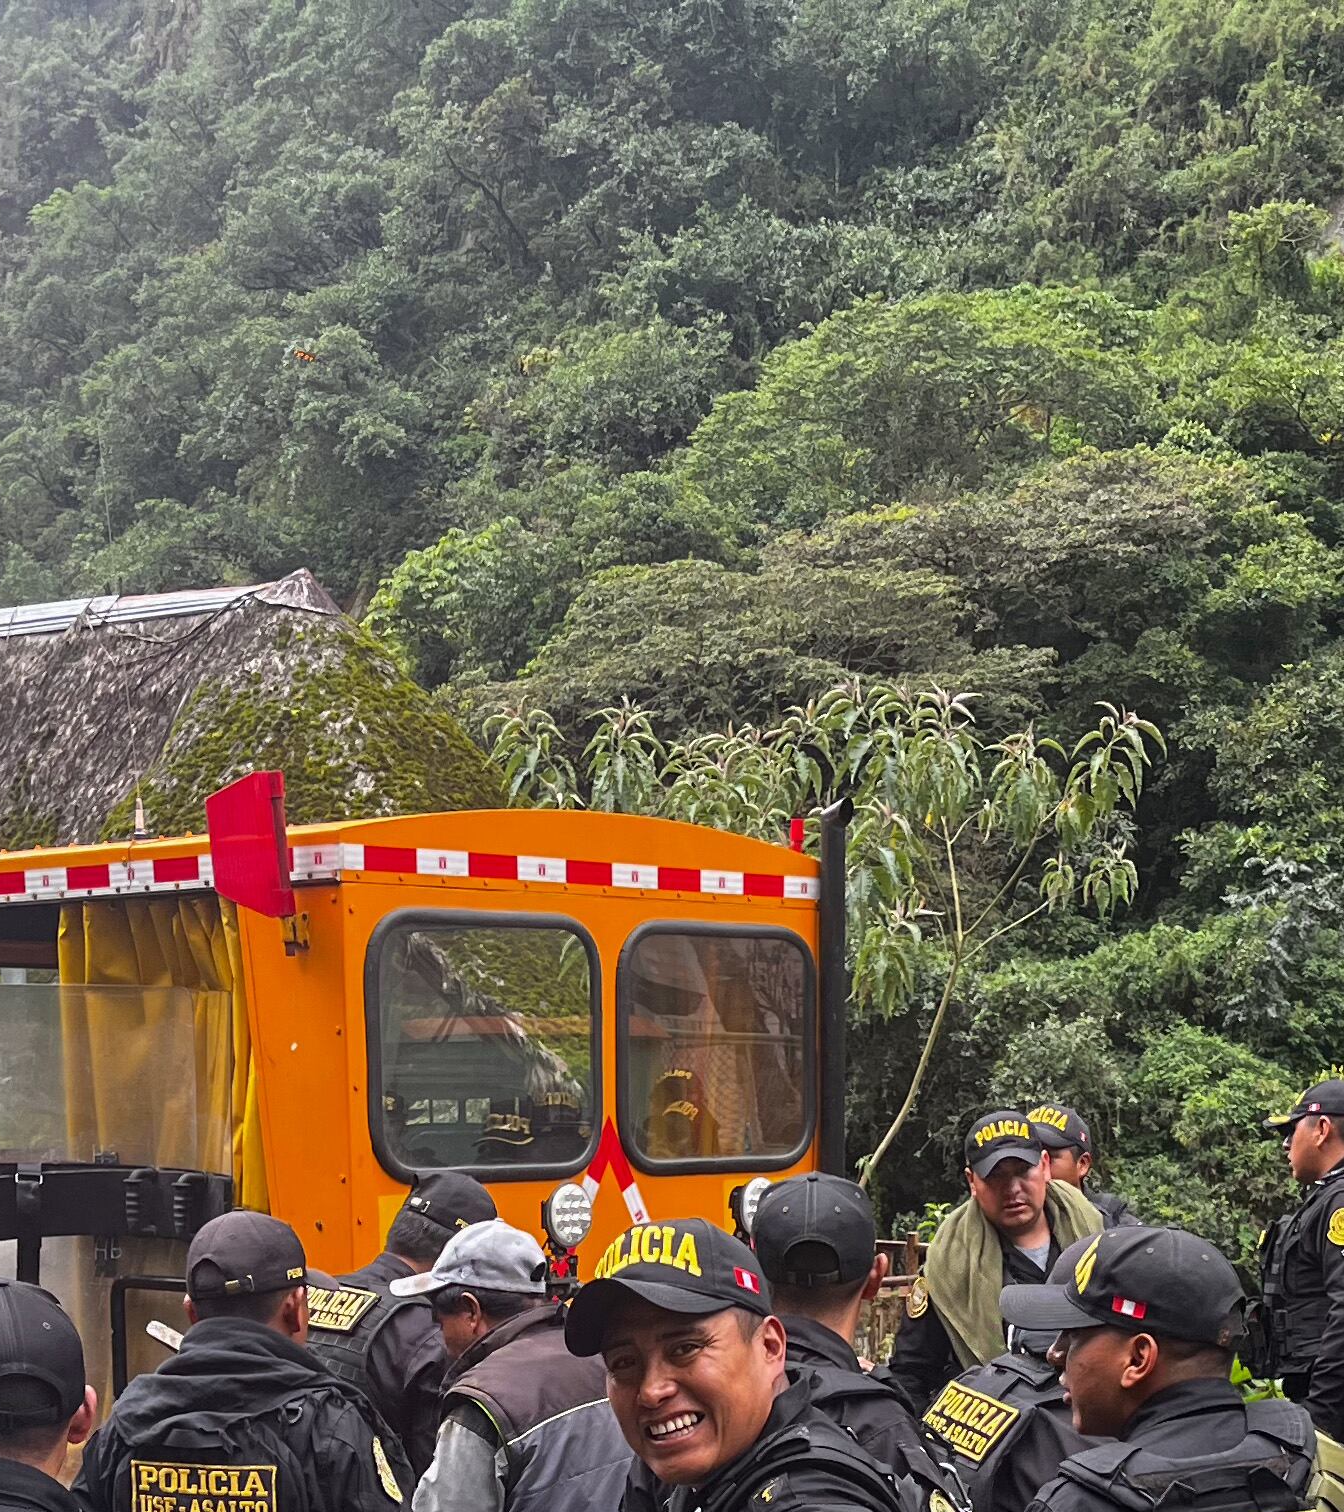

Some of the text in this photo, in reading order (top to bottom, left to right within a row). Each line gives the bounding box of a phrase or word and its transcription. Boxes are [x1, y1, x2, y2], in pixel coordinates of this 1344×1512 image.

[975, 1120, 1030, 1147] POLICIA
[932, 1389, 1007, 1436] POLICIA
[139, 1465, 269, 1497] POLICIA
